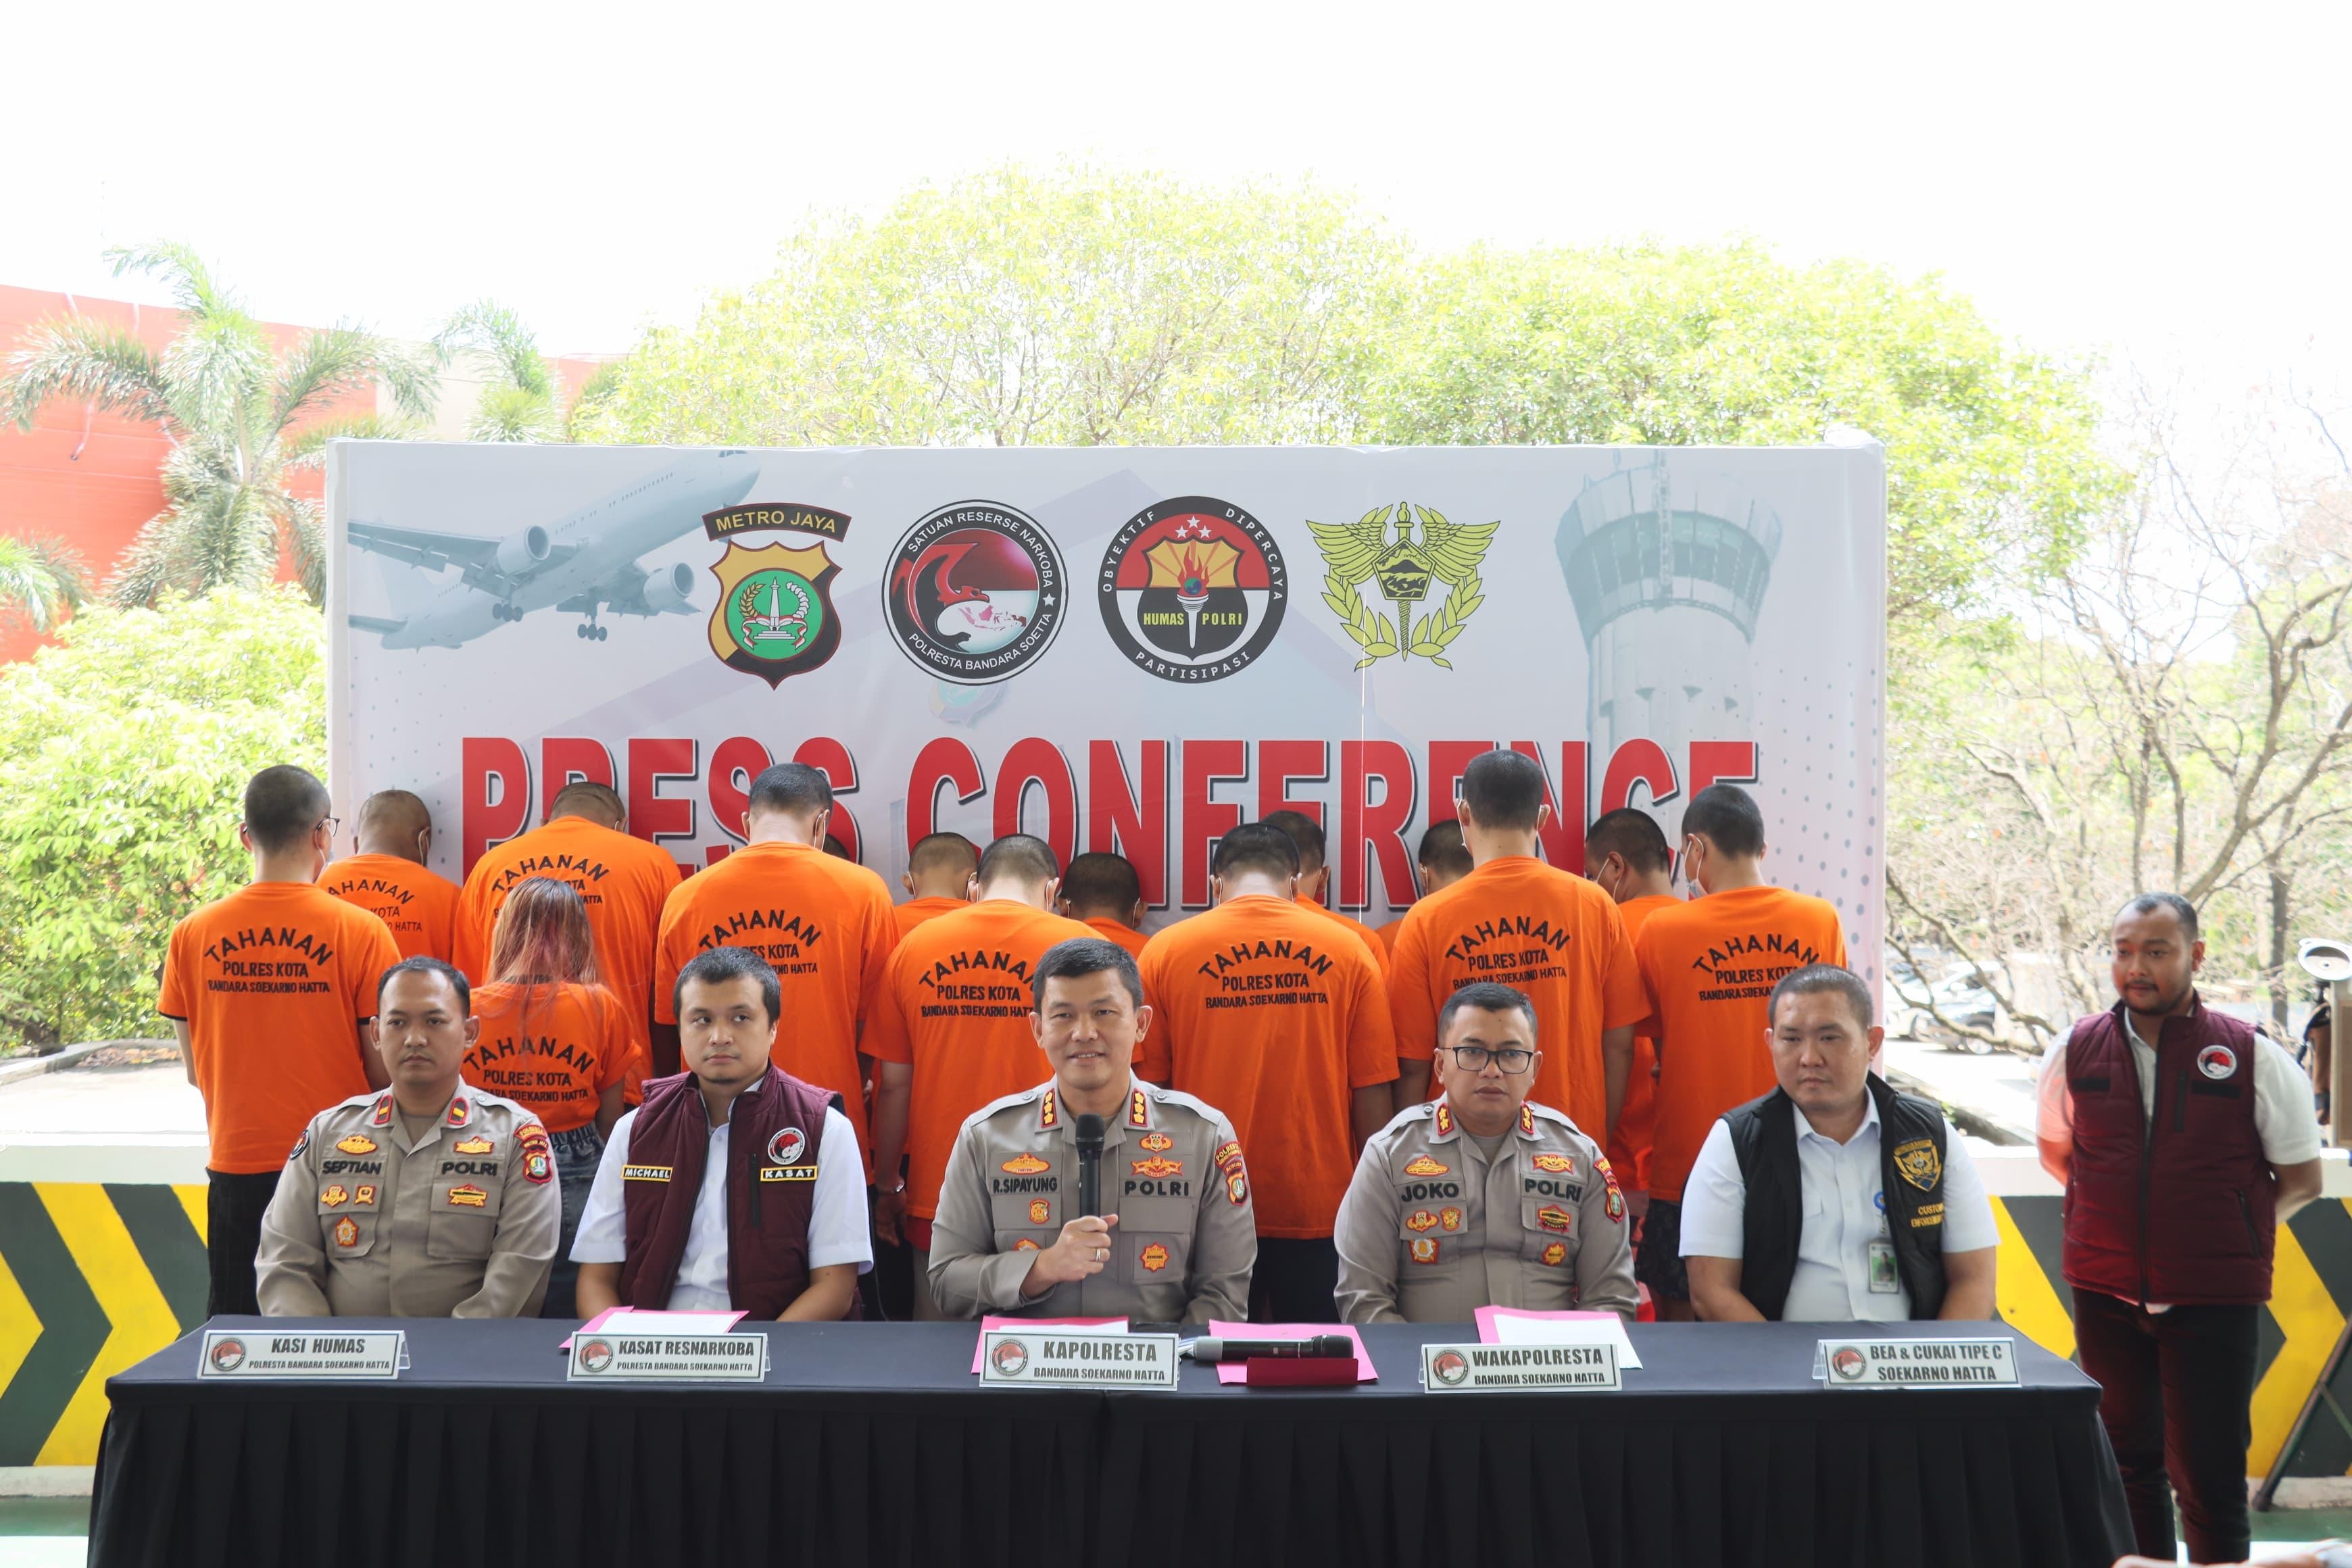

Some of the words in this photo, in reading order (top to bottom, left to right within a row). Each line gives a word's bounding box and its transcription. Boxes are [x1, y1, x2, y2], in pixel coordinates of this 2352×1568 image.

[715, 510, 785, 532] METRO
[790, 512, 837, 533] JAYA
[908, 516, 954, 552] SATUAN
[957, 512, 1020, 533] RESERSE
[1019, 529, 1053, 588] NARKOBA
[1103, 511, 1154, 592] OBYEKTIF
[1225, 508, 1283, 600] DIPERCAYA
[1143, 612, 1184, 625] HUMAS
[1202, 612, 1242, 625] POLRI
[908, 633, 962, 669] POLRESTA
[965, 648, 1021, 670] BANDARA
[1020, 614, 1052, 652] SOETTA
[1135, 652, 1250, 679] PARTISIPASI
[492, 854, 610, 892] TAHANAN
[328, 879, 415, 904] AHANAN
[581, 894, 603, 905] ATTA
[395, 921, 422, 931] HATTA
[698, 910, 821, 948] TAHANAN
[204, 927, 334, 966] TAHANAN
[1445, 915, 1571, 961] TAHANAN
[768, 944, 800, 959] KOTA
[1198, 939, 1333, 980] TAHANAN
[1468, 953, 1517, 972] POLRES
[1520, 948, 1549, 964] KOTA
[1692, 933, 1820, 973] TAHANAN
[222, 960, 274, 977] POLRES
[276, 962, 309, 978] KOTA
[790, 962, 818, 974] HATTA
[1496, 969, 1538, 985] SOEKARNO
[1540, 966, 1567, 979] HATTA
[1715, 969, 1764, 984] POLRES
[1767, 966, 1798, 981] KOT
[208, 980, 249, 993] BANDARA
[249, 981, 297, 994] SOEKARNO
[299, 981, 330, 994] HATTA
[1221, 974, 1273, 991] POLRES
[1275, 972, 1310, 989] KOTA
[937, 984, 985, 1001] POLRES
[988, 985, 1021, 1001] KOTA
[1205, 996, 1248, 1009] BANDARA
[1249, 992, 1298, 1006] SOEKARNO
[1299, 992, 1329, 1004] HATTA
[1698, 987, 1742, 1001] BANDARA
[1742, 985, 1774, 999] SOEKA
[921, 1005, 959, 1018] BANDARA
[960, 1004, 1008, 1017] SOEKARNO
[1010, 1006, 1033, 1017] HATT
[463, 1036, 595, 1075] TAHANAN
[483, 1069, 533, 1086] POLRES
[537, 1072, 572, 1087] KOTA
[509, 1089, 559, 1102] SOEKARNO
[562, 1088, 589, 1102] HATTA
[322, 1160, 382, 1175] SEPTIAN
[441, 1161, 497, 1176] POLRI
[624, 1168, 670, 1179] MICHAEL
[765, 1169, 813, 1179] KASAT
[993, 1177, 1058, 1194] R.SIPAYUNG
[1125, 1180, 1190, 1196] POLRI
[1401, 1183, 1460, 1203] JOKO
[1524, 1178, 1583, 1203] POLRI
[272, 1338, 305, 1353] KASI
[312, 1339, 366, 1353] HUMAS
[618, 1340, 663, 1355] KASAT
[665, 1341, 754, 1356] RESNARKOBA
[1044, 1341, 1157, 1362] KAPOLRESTA
[1870, 1346, 1894, 1360] BEA
[1900, 1348, 1910, 1360] &
[1913, 1345, 1956, 1359] CUKAI
[1959, 1345, 1990, 1359] TIPE
[1994, 1345, 2003, 1360] C
[249, 1361, 286, 1369] POLRESTA
[288, 1361, 323, 1369] BANDARA
[324, 1361, 364, 1369] SOEKARNO
[366, 1361, 390, 1369] HATTA
[1472, 1348, 1604, 1367] WAKAPOLRESTA
[617, 1362, 653, 1370] POLRESTA
[654, 1363, 688, 1371] BANDARA
[689, 1363, 728, 1371] SOEKARNO
[1033, 1367, 1079, 1379] BANDARA
[1081, 1369, 1131, 1379] SOEKARNO
[1134, 1370, 1165, 1381] HATTA
[1878, 1366, 1949, 1380] SOEKARNO
[1953, 1366, 1996, 1380] HATTA
[1474, 1374, 1520, 1385] BANDARA
[1522, 1373, 1572, 1384] SOEKARNO
[1575, 1373, 1605, 1383] HATTA
